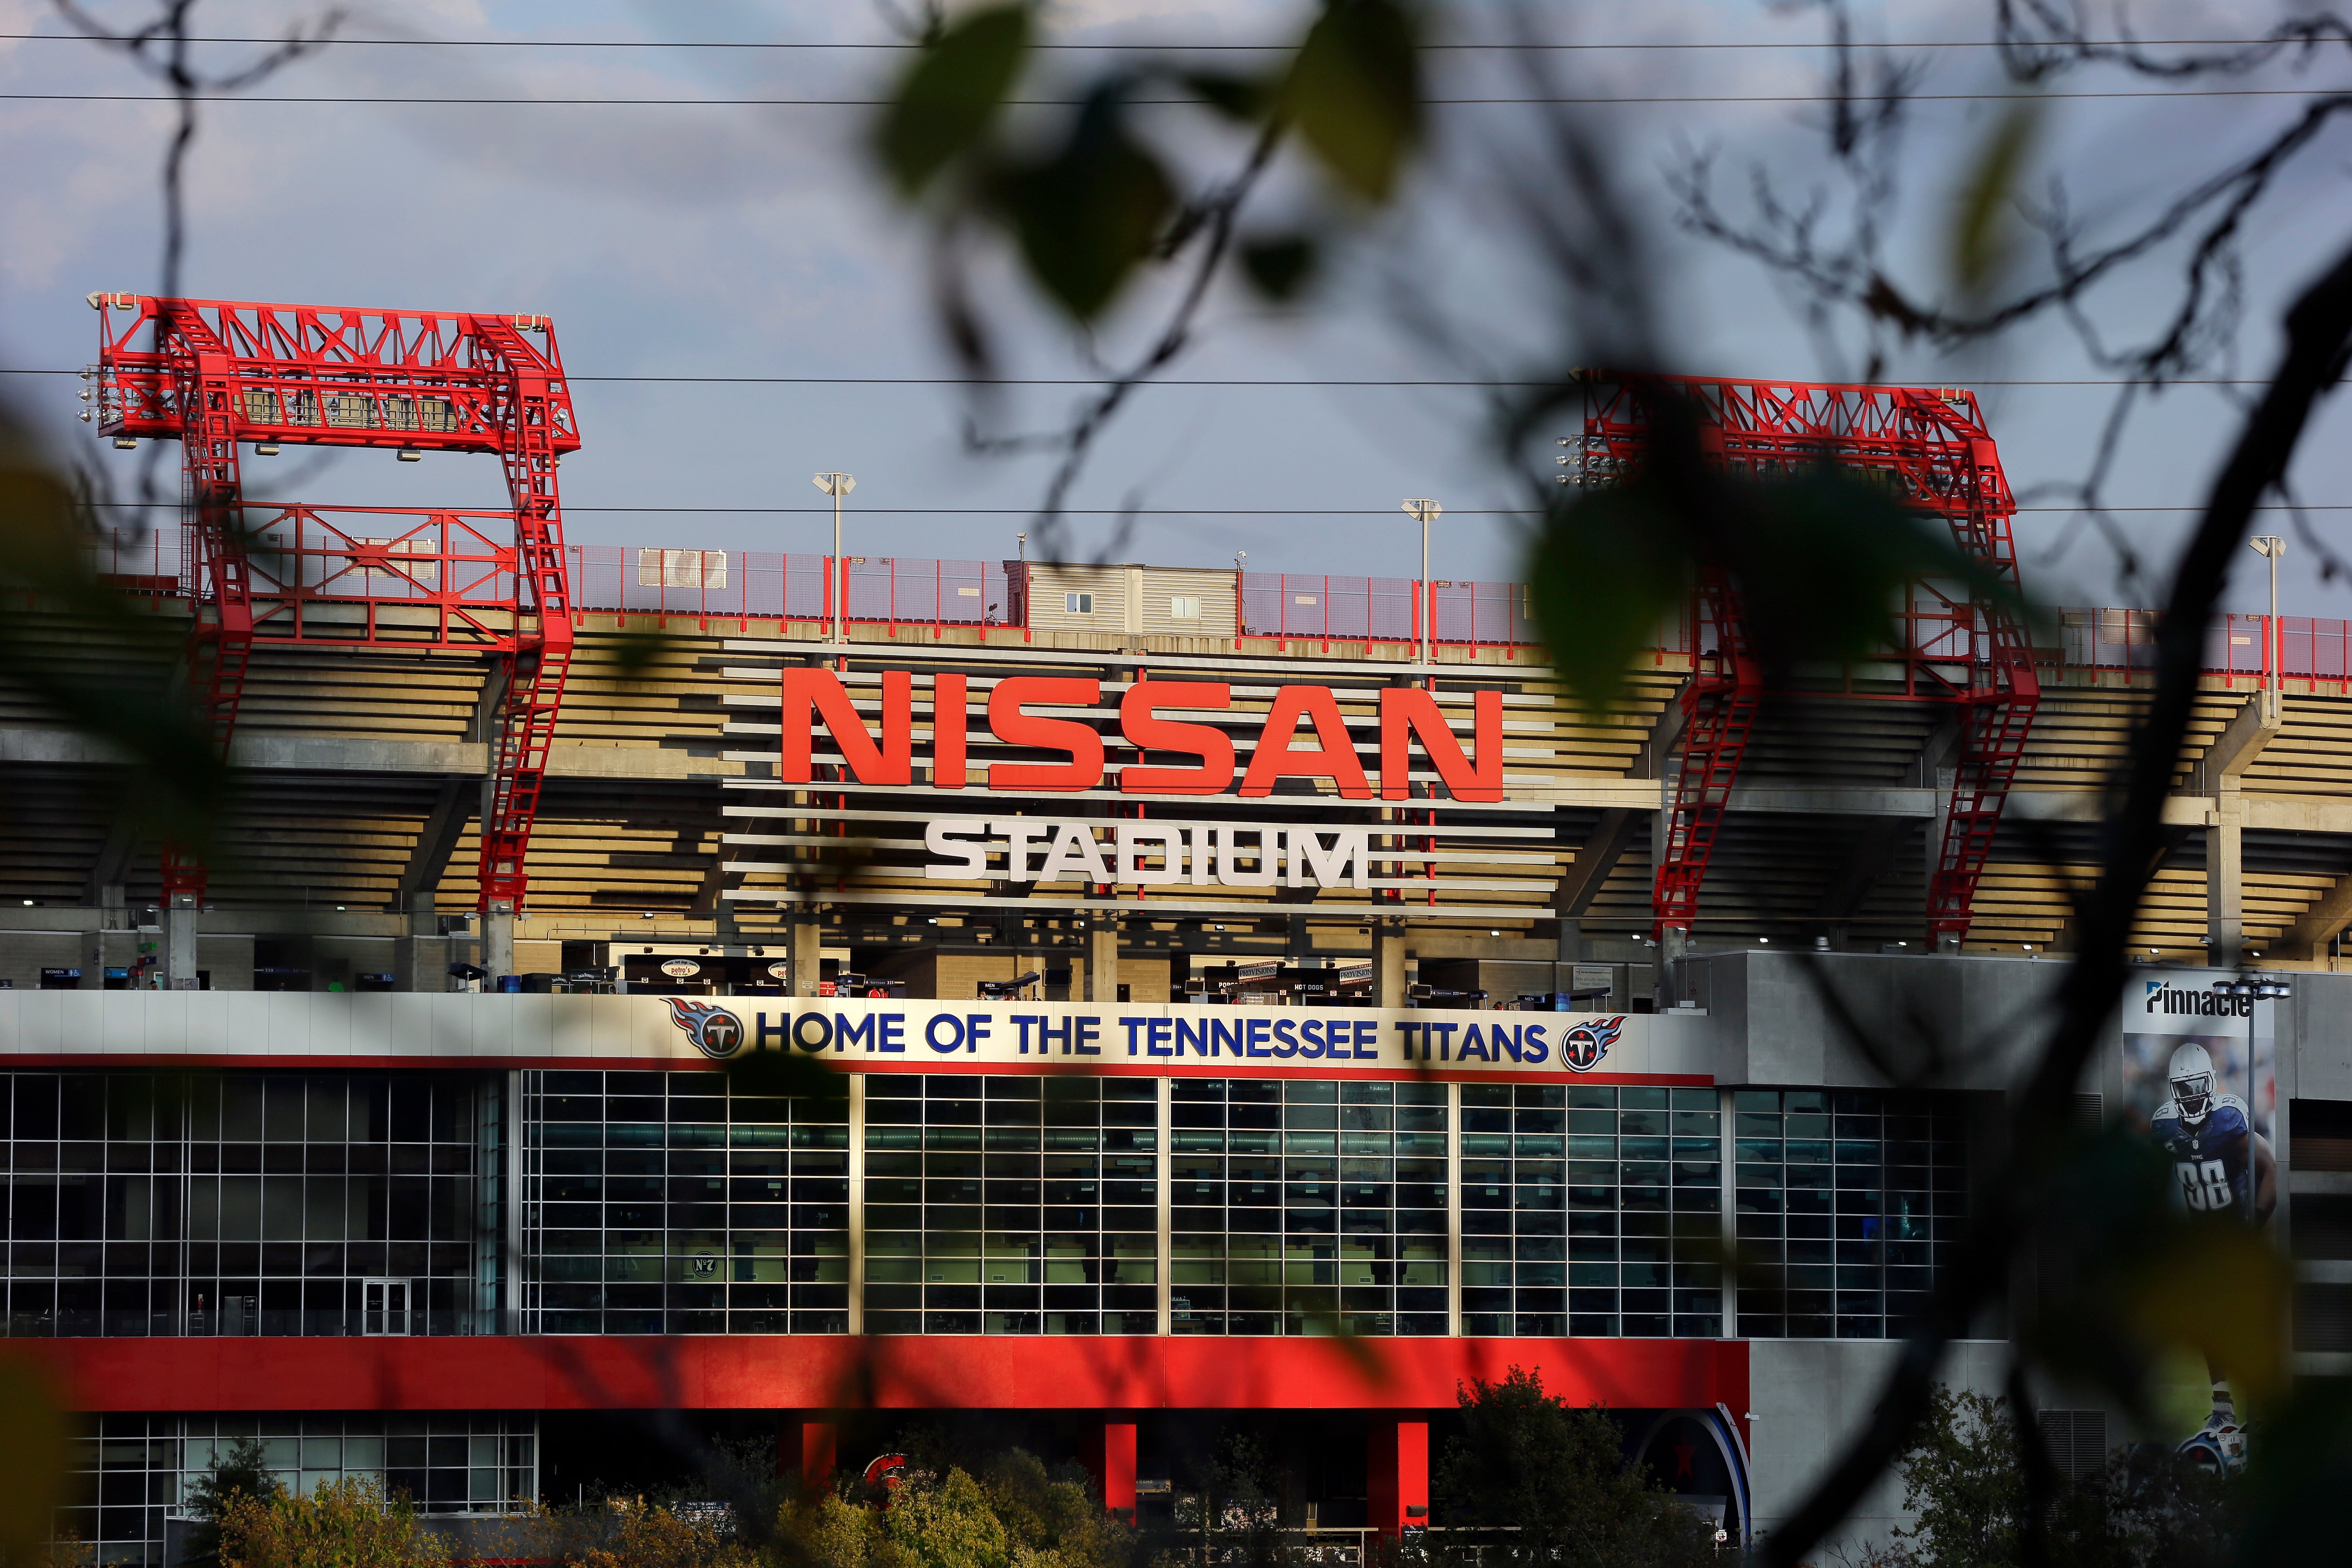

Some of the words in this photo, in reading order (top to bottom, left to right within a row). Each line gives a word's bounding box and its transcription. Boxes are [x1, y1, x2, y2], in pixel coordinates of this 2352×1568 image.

[782, 667, 1503, 803] NISSAN
[925, 819, 1368, 889] STADIUM
[671, 966, 691, 975] petro's
[1240, 966, 1275, 977] PROVISIONS
[1341, 969, 1372, 979] PROVISION
[2146, 980, 2250, 1018] Pinnacle
[757, 1012, 905, 1053] HOME
[925, 1013, 992, 1054] OF
[1010, 1014, 1101, 1055] THE
[1119, 1016, 1378, 1059] TENNESSEE
[1395, 1021, 1549, 1063] TITANS
[2176, 1159, 2234, 1211] 98
